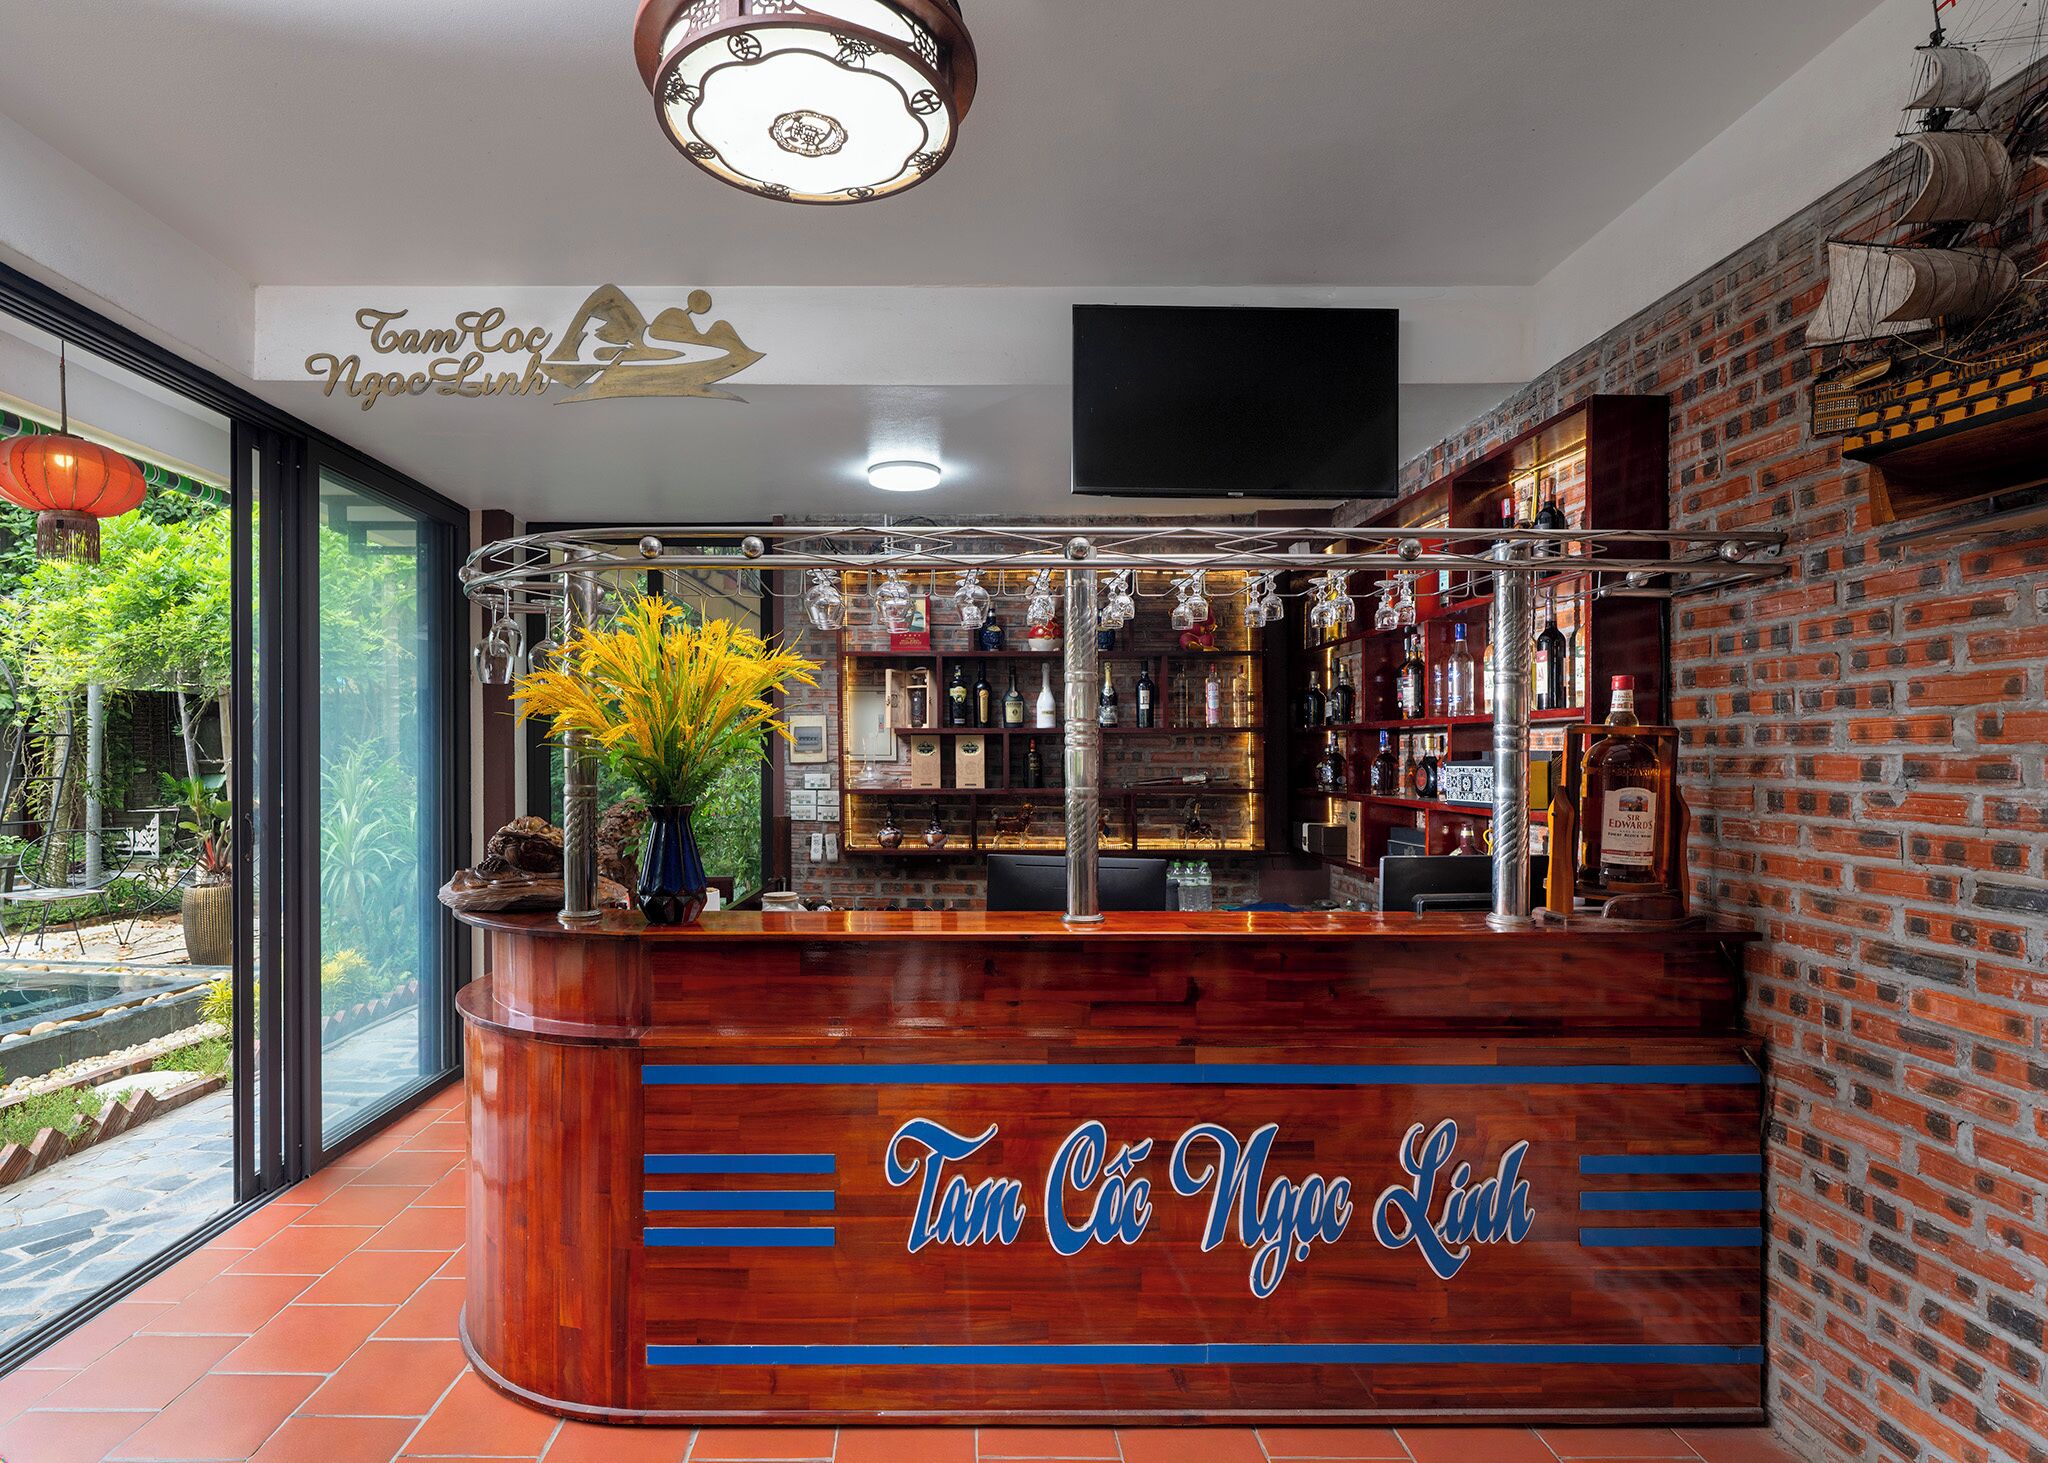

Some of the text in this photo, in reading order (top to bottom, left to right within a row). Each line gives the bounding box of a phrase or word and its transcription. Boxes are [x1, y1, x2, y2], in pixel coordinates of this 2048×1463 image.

[885, 1117, 1535, 1298] Tam Cốc Ngọc Linh
